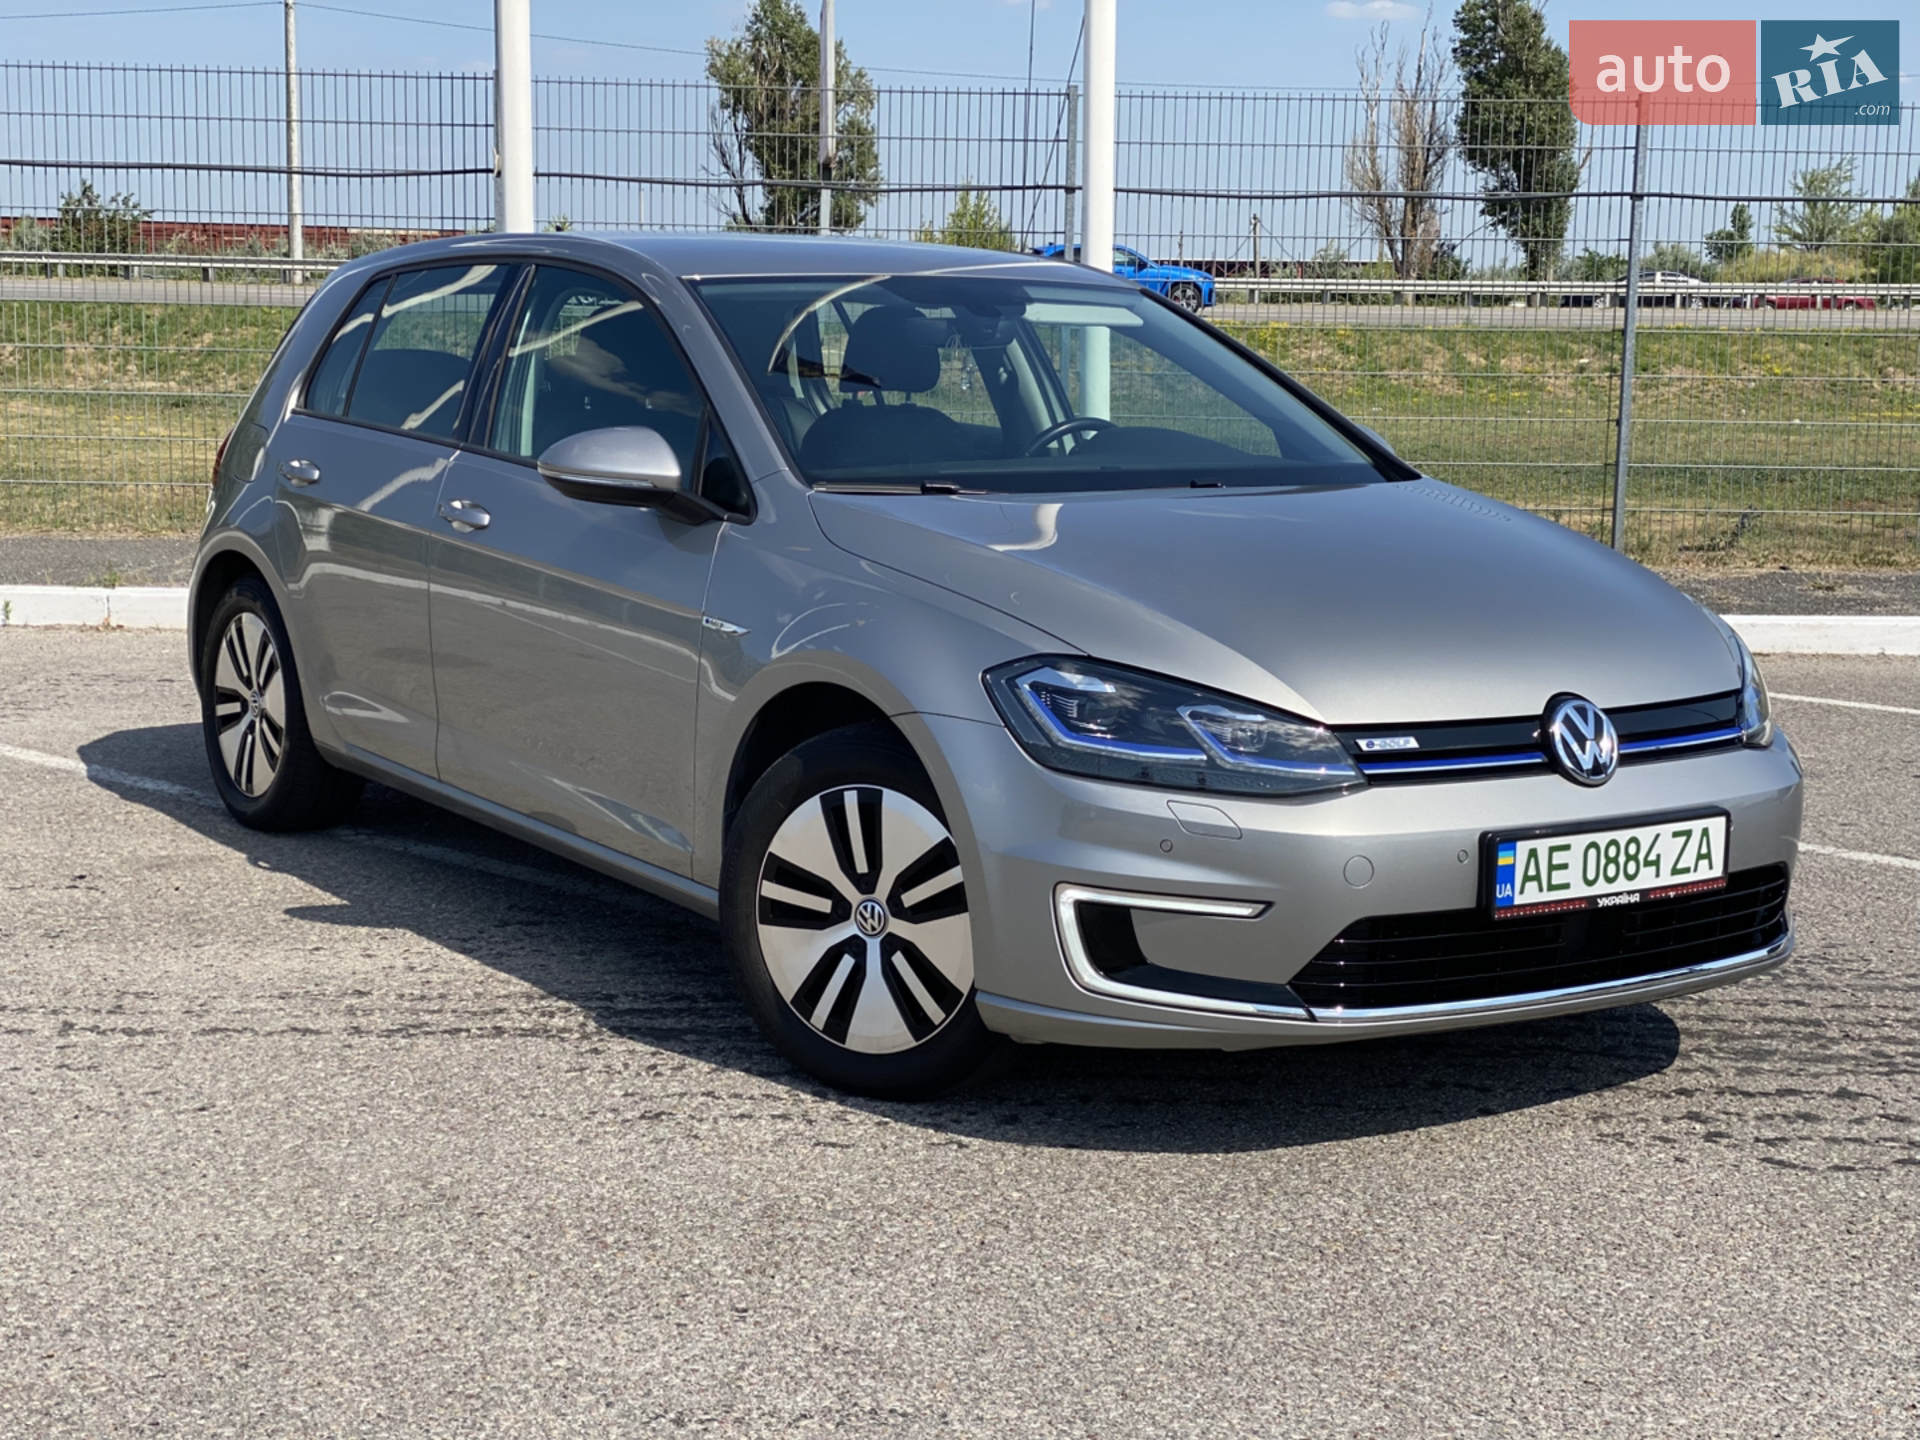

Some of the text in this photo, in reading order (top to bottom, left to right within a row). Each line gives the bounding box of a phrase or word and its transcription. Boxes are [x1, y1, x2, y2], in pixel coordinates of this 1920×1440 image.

[1519, 827, 1714, 895] AE 0884 ZA
[1496, 882, 1513, 898] UA
